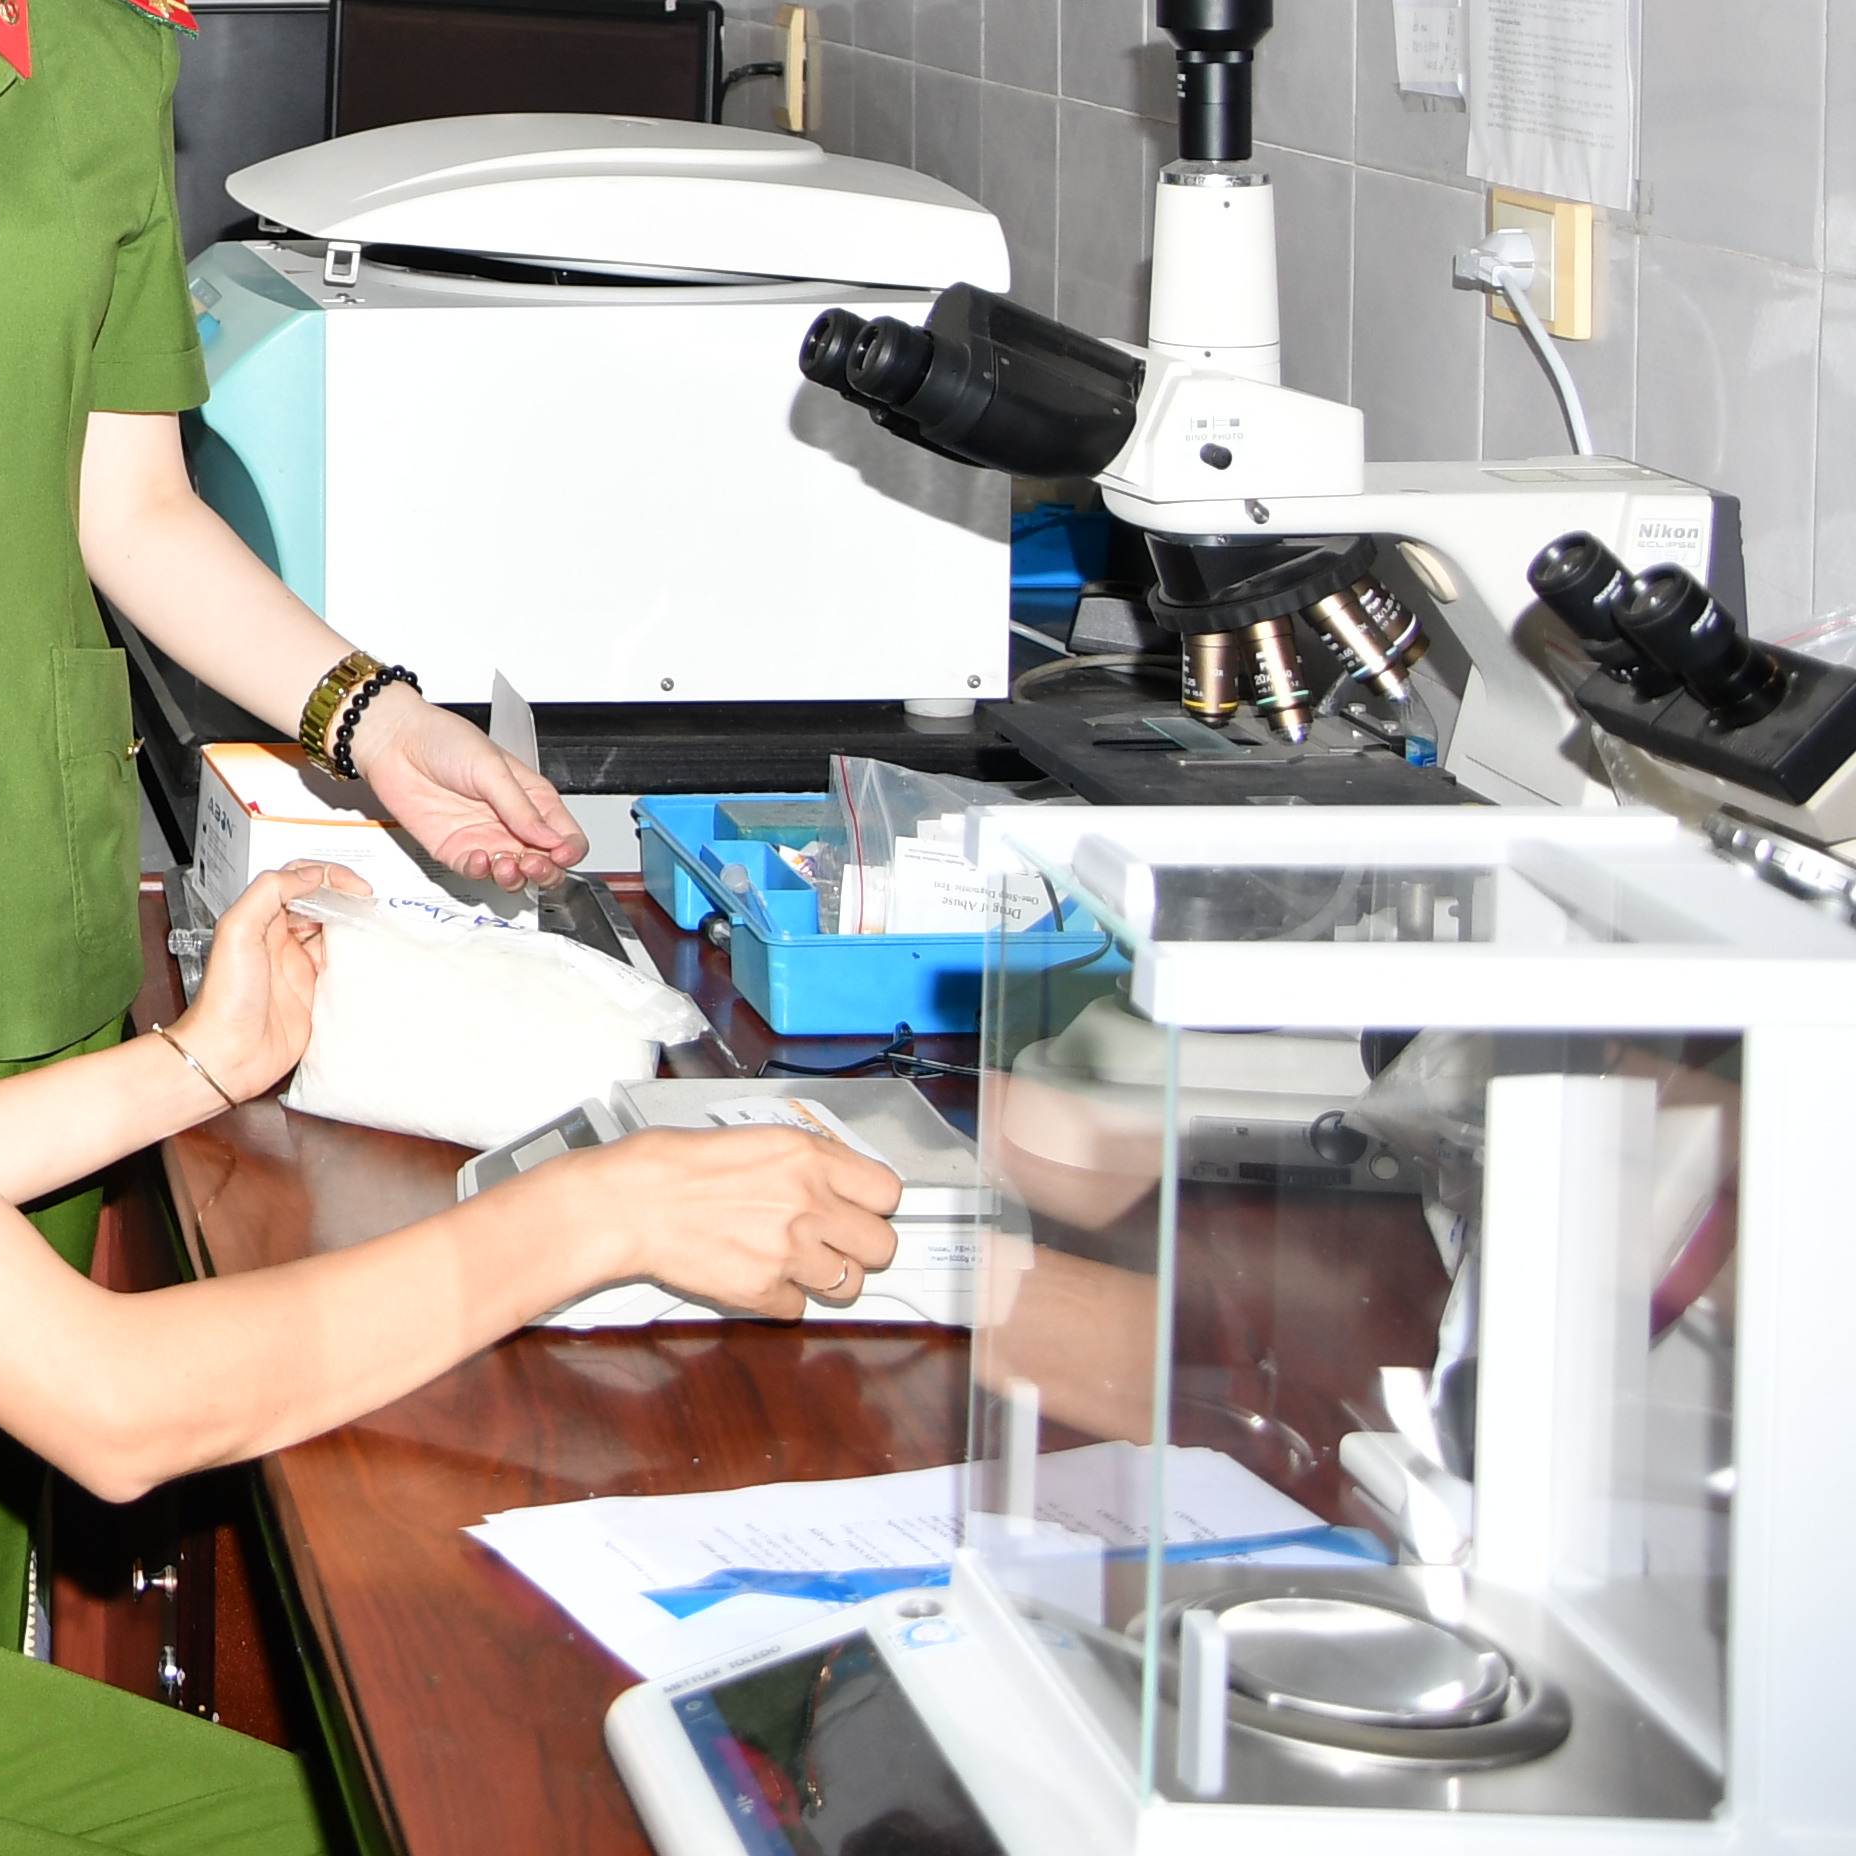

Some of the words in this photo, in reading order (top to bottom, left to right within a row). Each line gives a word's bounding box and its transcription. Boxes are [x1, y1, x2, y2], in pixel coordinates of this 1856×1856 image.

[1212, 432, 1244, 441] PHOTO
[1638, 523, 1699, 539] Nikon
[1637, 540, 1696, 549] ECLIPSE
[941, 897, 978, 912] Abuse
[729, 1645, 781, 1669] TOLEDO
